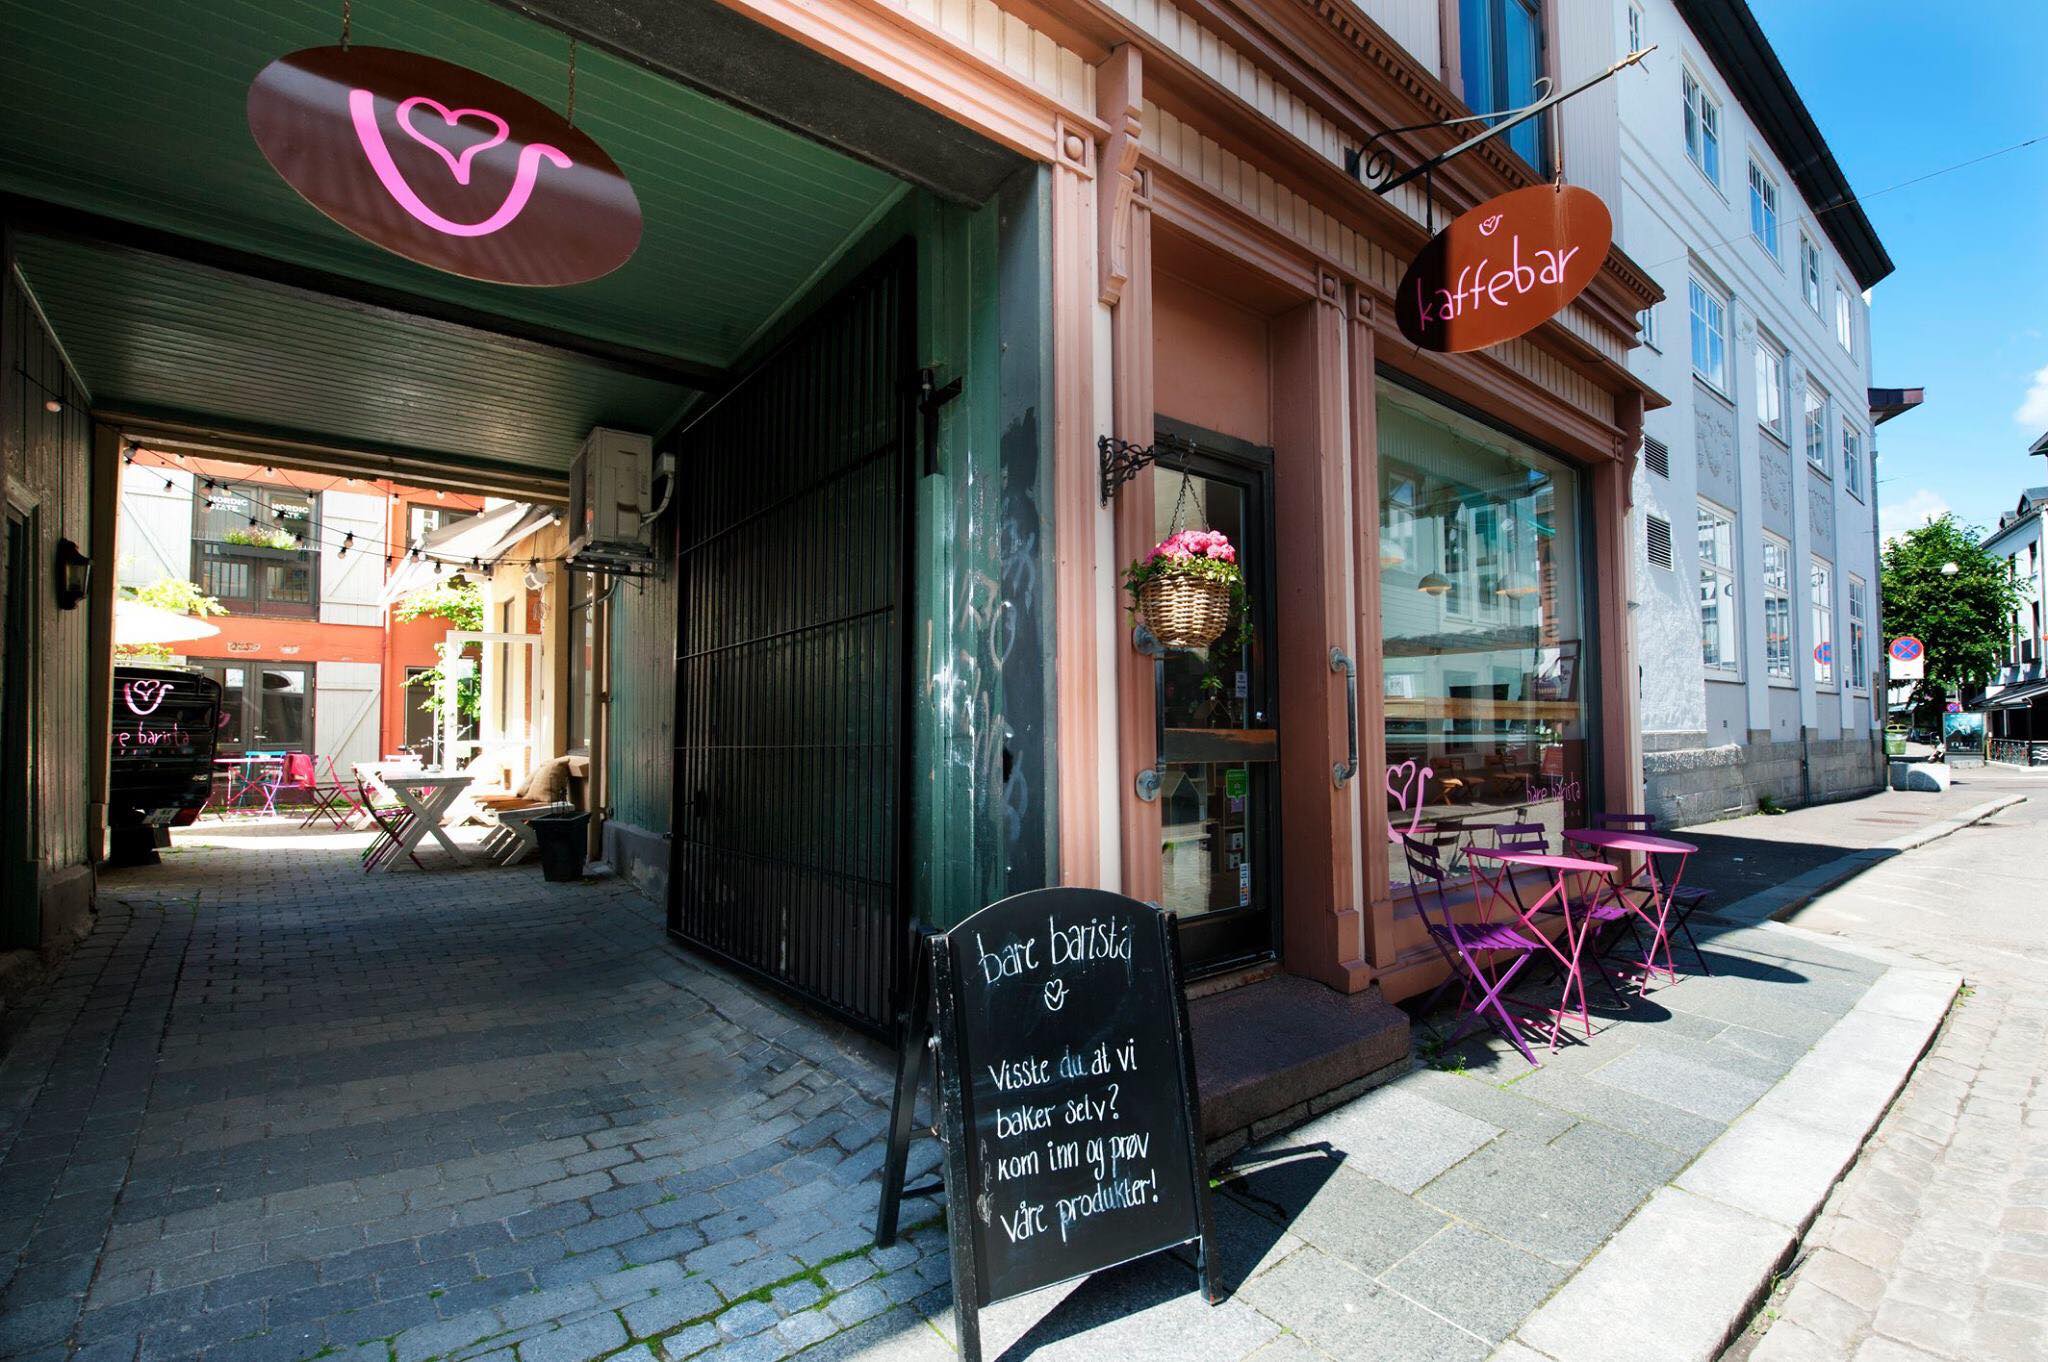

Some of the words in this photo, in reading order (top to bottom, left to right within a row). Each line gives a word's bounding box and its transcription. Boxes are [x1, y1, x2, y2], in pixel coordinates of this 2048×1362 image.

[1417, 235, 1580, 331] kaffebar
[208, 495, 249, 506] NORDIC
[271, 502, 309, 514] NORDIC
[138, 721, 190, 748] barista
[977, 933, 1040, 984] bare
[1050, 915, 1133, 966] barista
[988, 1055, 1051, 1091] Visste
[1059, 1044, 1089, 1079] du
[1091, 1041, 1112, 1076] at
[1116, 1037, 1138, 1072] vi
[996, 1104, 1057, 1139] baker
[1047, 1140, 1080, 1171] inn
[1086, 1137, 1105, 1180] og
[1108, 1132, 1150, 1178] prøv
[1056, 1167, 1159, 1243] produkter!
